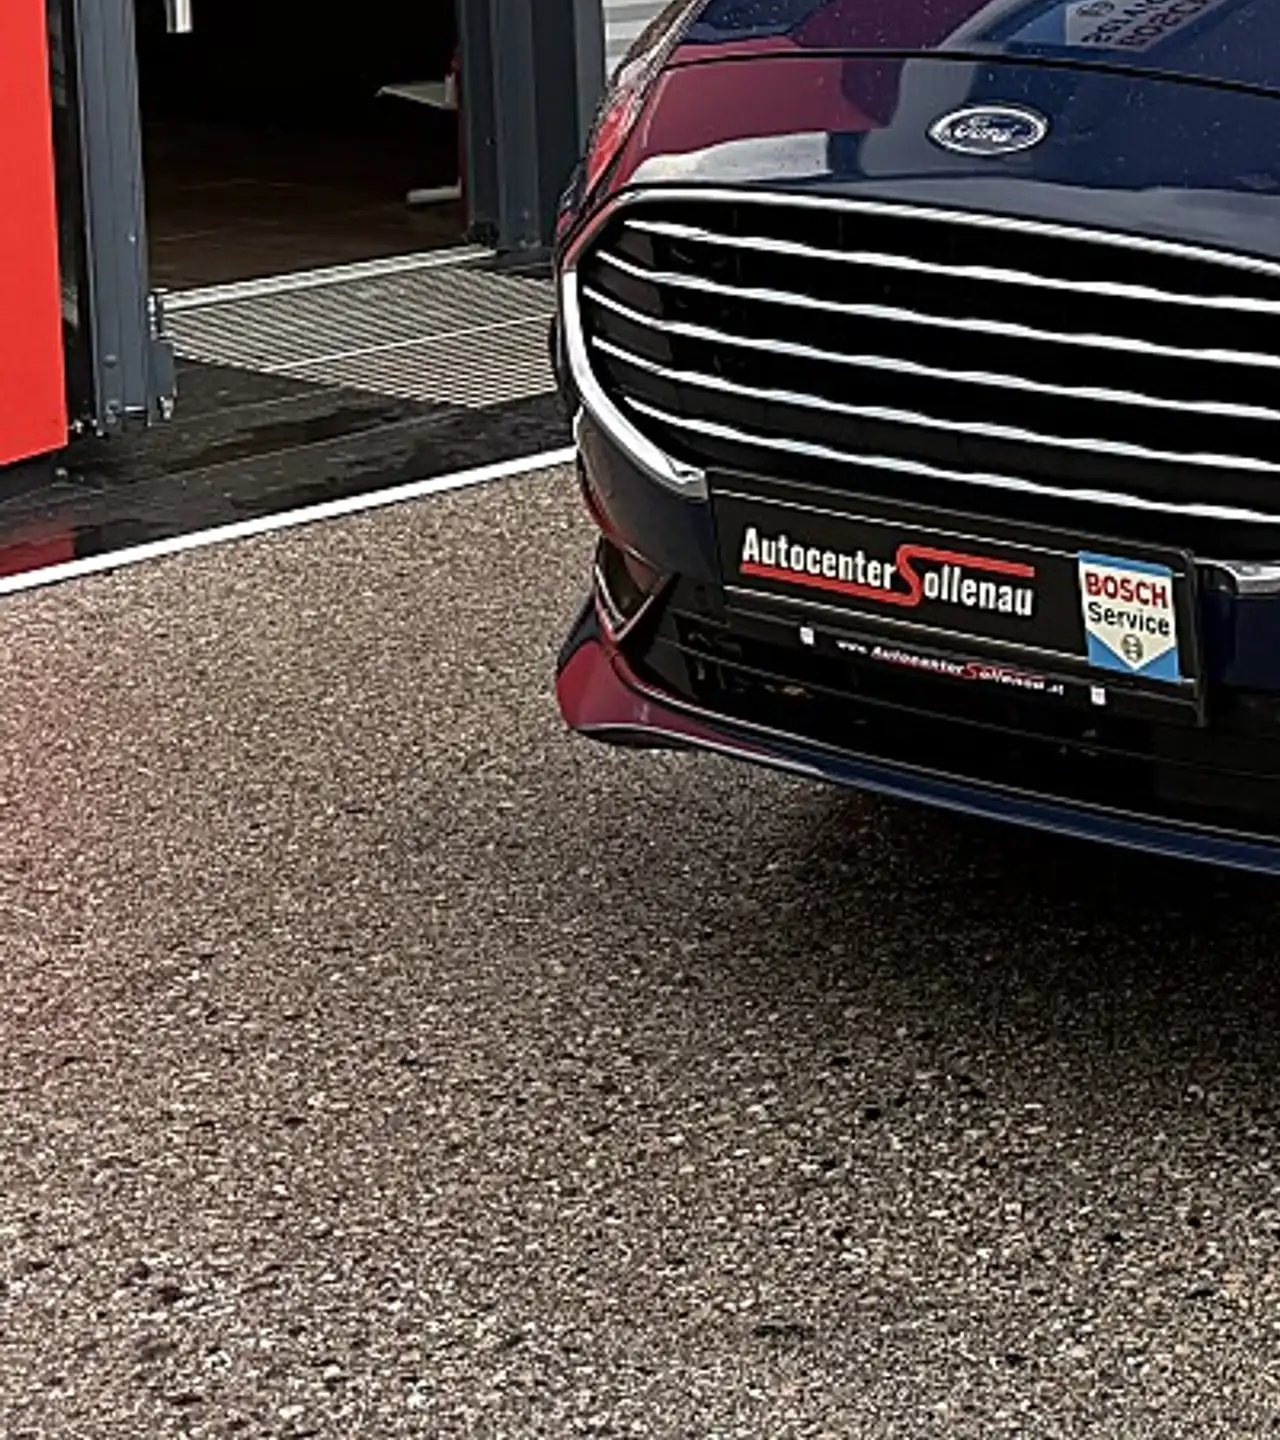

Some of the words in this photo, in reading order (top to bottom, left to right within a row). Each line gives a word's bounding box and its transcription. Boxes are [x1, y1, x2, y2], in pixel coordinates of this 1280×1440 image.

[953, 115, 1020, 144] Ford
[1084, 569, 1170, 609] BOSCH
[1087, 604, 1171, 637] Service
